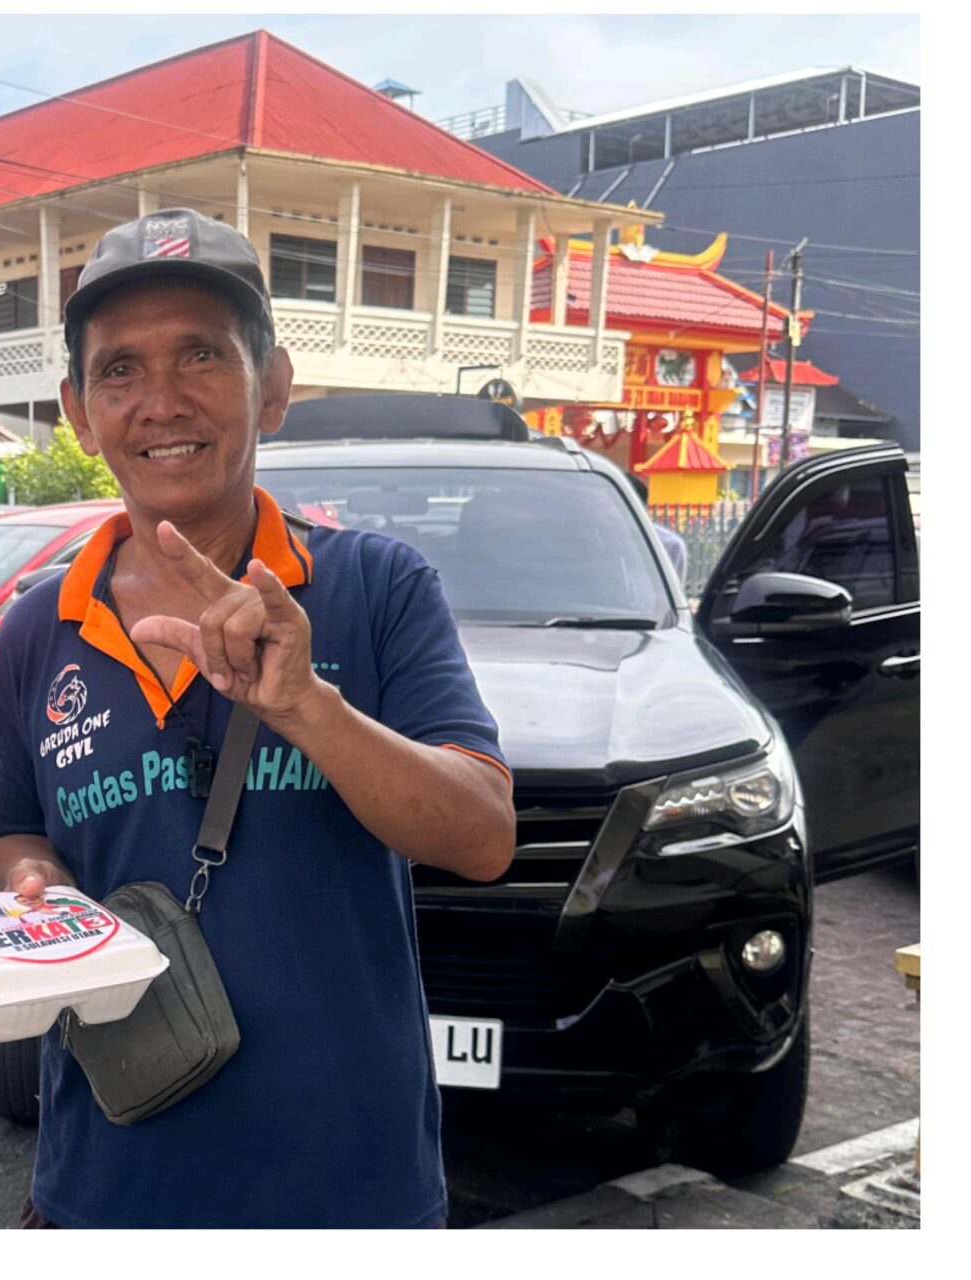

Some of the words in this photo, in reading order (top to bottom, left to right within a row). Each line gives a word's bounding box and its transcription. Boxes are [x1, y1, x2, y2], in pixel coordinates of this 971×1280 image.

[40, 723, 79, 758] GARUDA
[81, 709, 111, 735] ONE
[56, 736, 94, 769] GSVL
[56, 769, 139, 829] Cerdas
[71, 928, 104, 941] UTARA
[446, 1026, 494, 1065] LU
